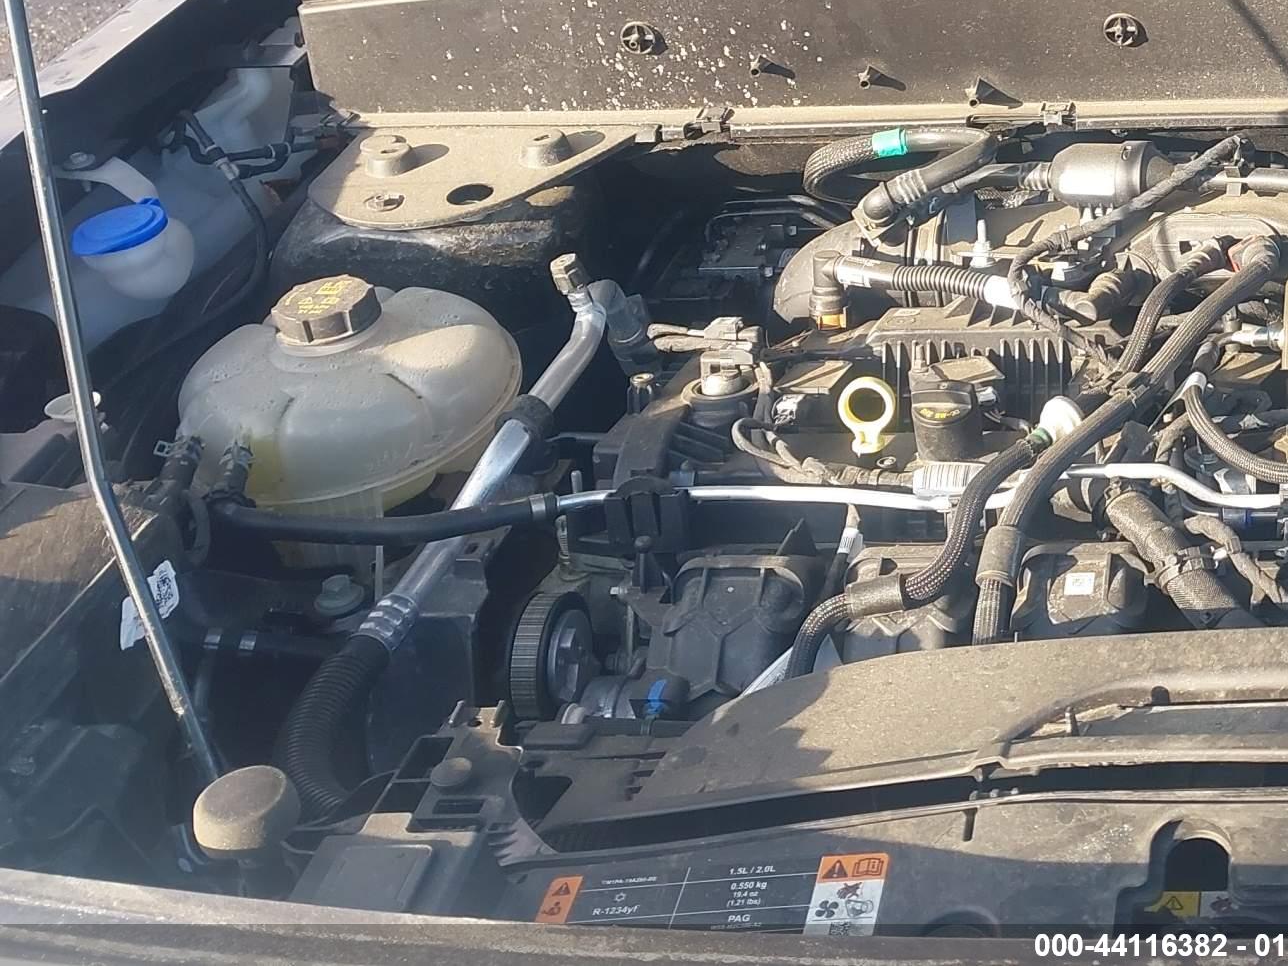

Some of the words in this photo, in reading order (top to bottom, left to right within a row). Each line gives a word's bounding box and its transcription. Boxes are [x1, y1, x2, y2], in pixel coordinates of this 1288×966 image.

[729, 867, 748, 875] 1.5L
[755, 865, 776, 873] 2.0L
[730, 882, 755, 891] 0.550
[755, 880, 768, 890] kg
[733, 890, 748, 898] 19.4
[726, 899, 745, 908] (1.21
[746, 897, 761, 906] lbs)
[592, 904, 639, 916] R-1234yf
[727, 914, 751, 922] PAG
